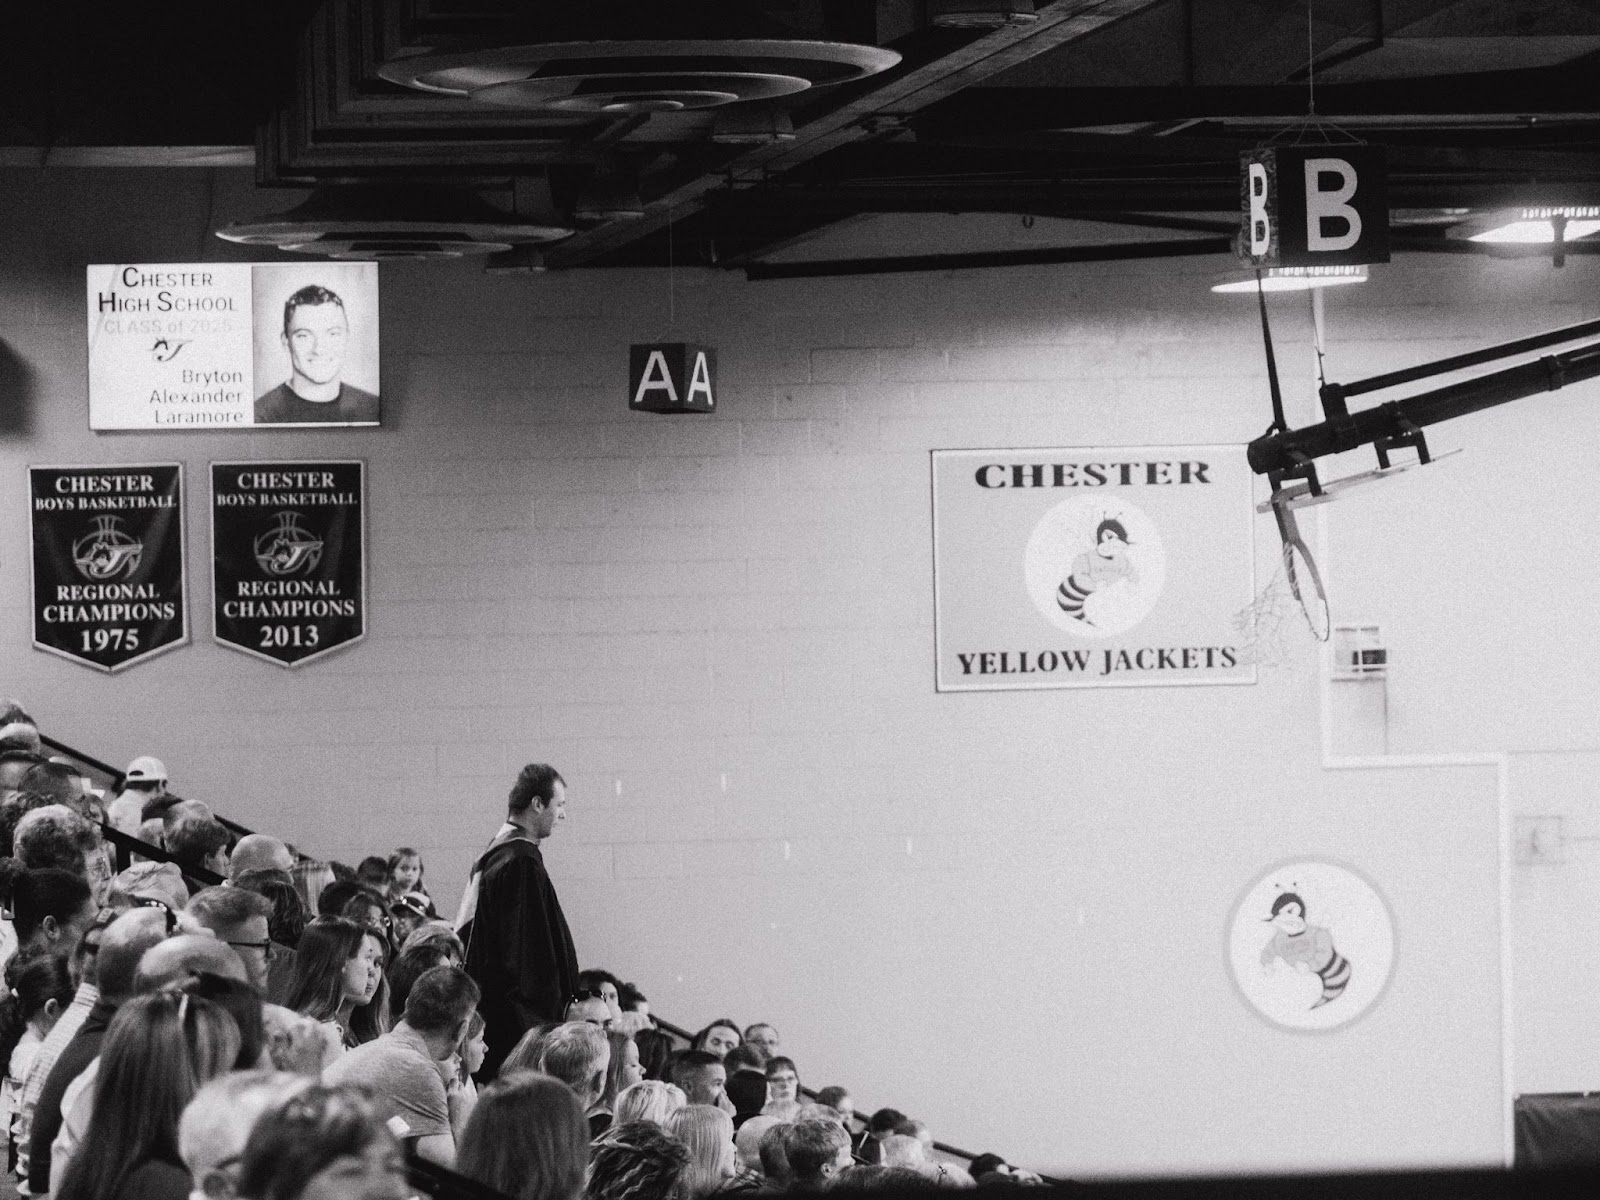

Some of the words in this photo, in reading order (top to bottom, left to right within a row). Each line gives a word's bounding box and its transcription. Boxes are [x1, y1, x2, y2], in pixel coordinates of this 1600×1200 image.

[1249, 162, 1271, 256] B
[1304, 157, 1363, 252] B
[121, 266, 214, 288] CHESTER
[98, 292, 150, 313] HIGH
[156, 291, 239, 312] SCHOOL
[103, 319, 163, 335] CLASS
[167, 319, 184, 334] of
[181, 369, 243, 386] Bryton
[634, 350, 679, 403] A
[686, 351, 714, 406] A
[149, 389, 242, 405] Alexander
[154, 408, 244, 424] Laramore
[54, 474, 155, 494] CHESTER
[237, 471, 336, 489] CHESTER
[974, 460, 1211, 489] CHESTER
[35, 497, 75, 511] BOYS
[78, 495, 177, 510] BASKETBALL
[216, 493, 257, 507] BOYS
[259, 492, 358, 506] BASKETBALL
[56, 582, 161, 602] REGIONAL
[237, 579, 341, 597] REGIONAL
[42, 602, 176, 623] CHAMPIONS
[222, 598, 356, 618] CHAMPIONS
[80, 627, 140, 652] 1975
[259, 624, 320, 648] 2013
[957, 649, 1093, 676] YELLOW
[1099, 645, 1238, 676] JACKETS
